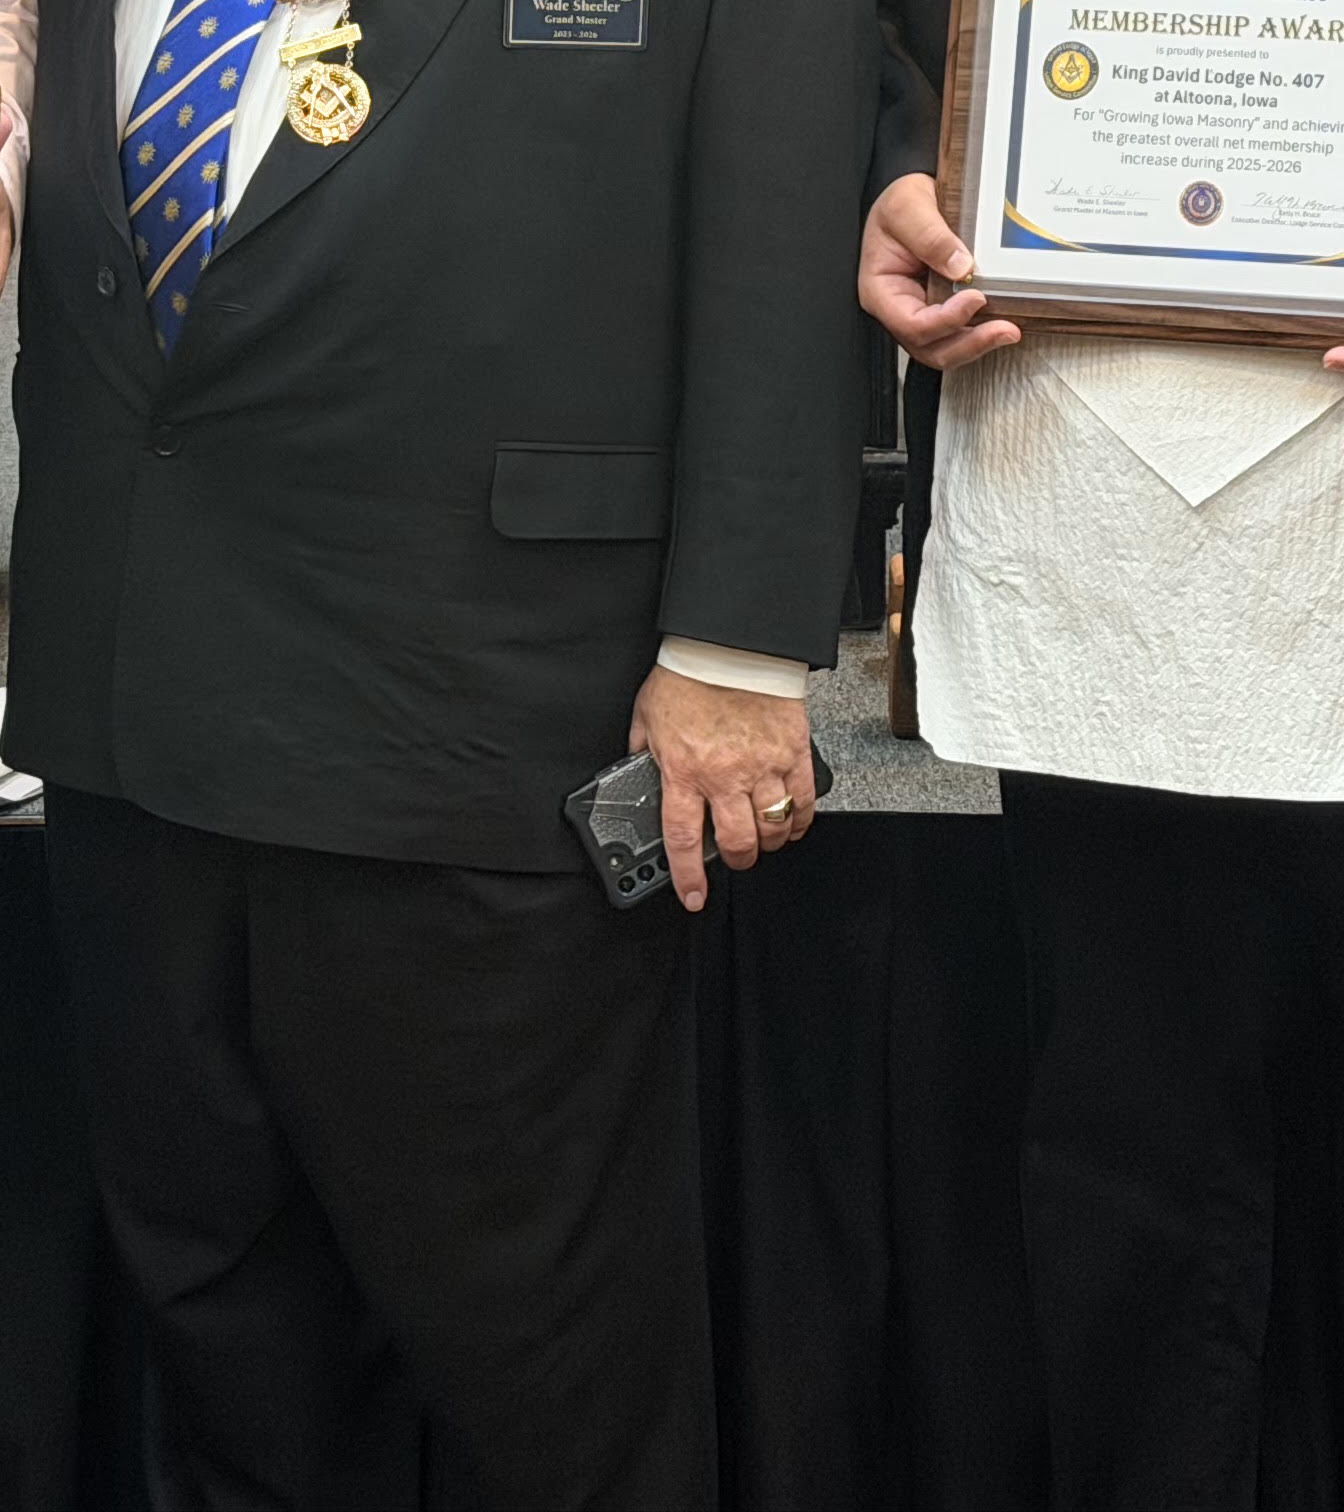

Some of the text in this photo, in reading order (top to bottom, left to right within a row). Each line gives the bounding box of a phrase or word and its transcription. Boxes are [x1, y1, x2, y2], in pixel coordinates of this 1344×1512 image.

[544, 14, 608, 25] Grand Master
[1068, 8, 1250, 37] MEMBERSHIP
[1156, 46, 1270, 60] is proudly presented to
[1112, 64, 1326, 89] King David Lodge No. 407
[1154, 90, 1279, 108] at Altoona, Iowa
[1073, 108, 1096, 121] For
[1162, 112, 1194, 126] Iowa
[1262, 118, 1289, 131] and
[1092, 130, 1335, 157] the greatest overall net membership
[1120, 151, 1303, 174] increase during 2025-2026
